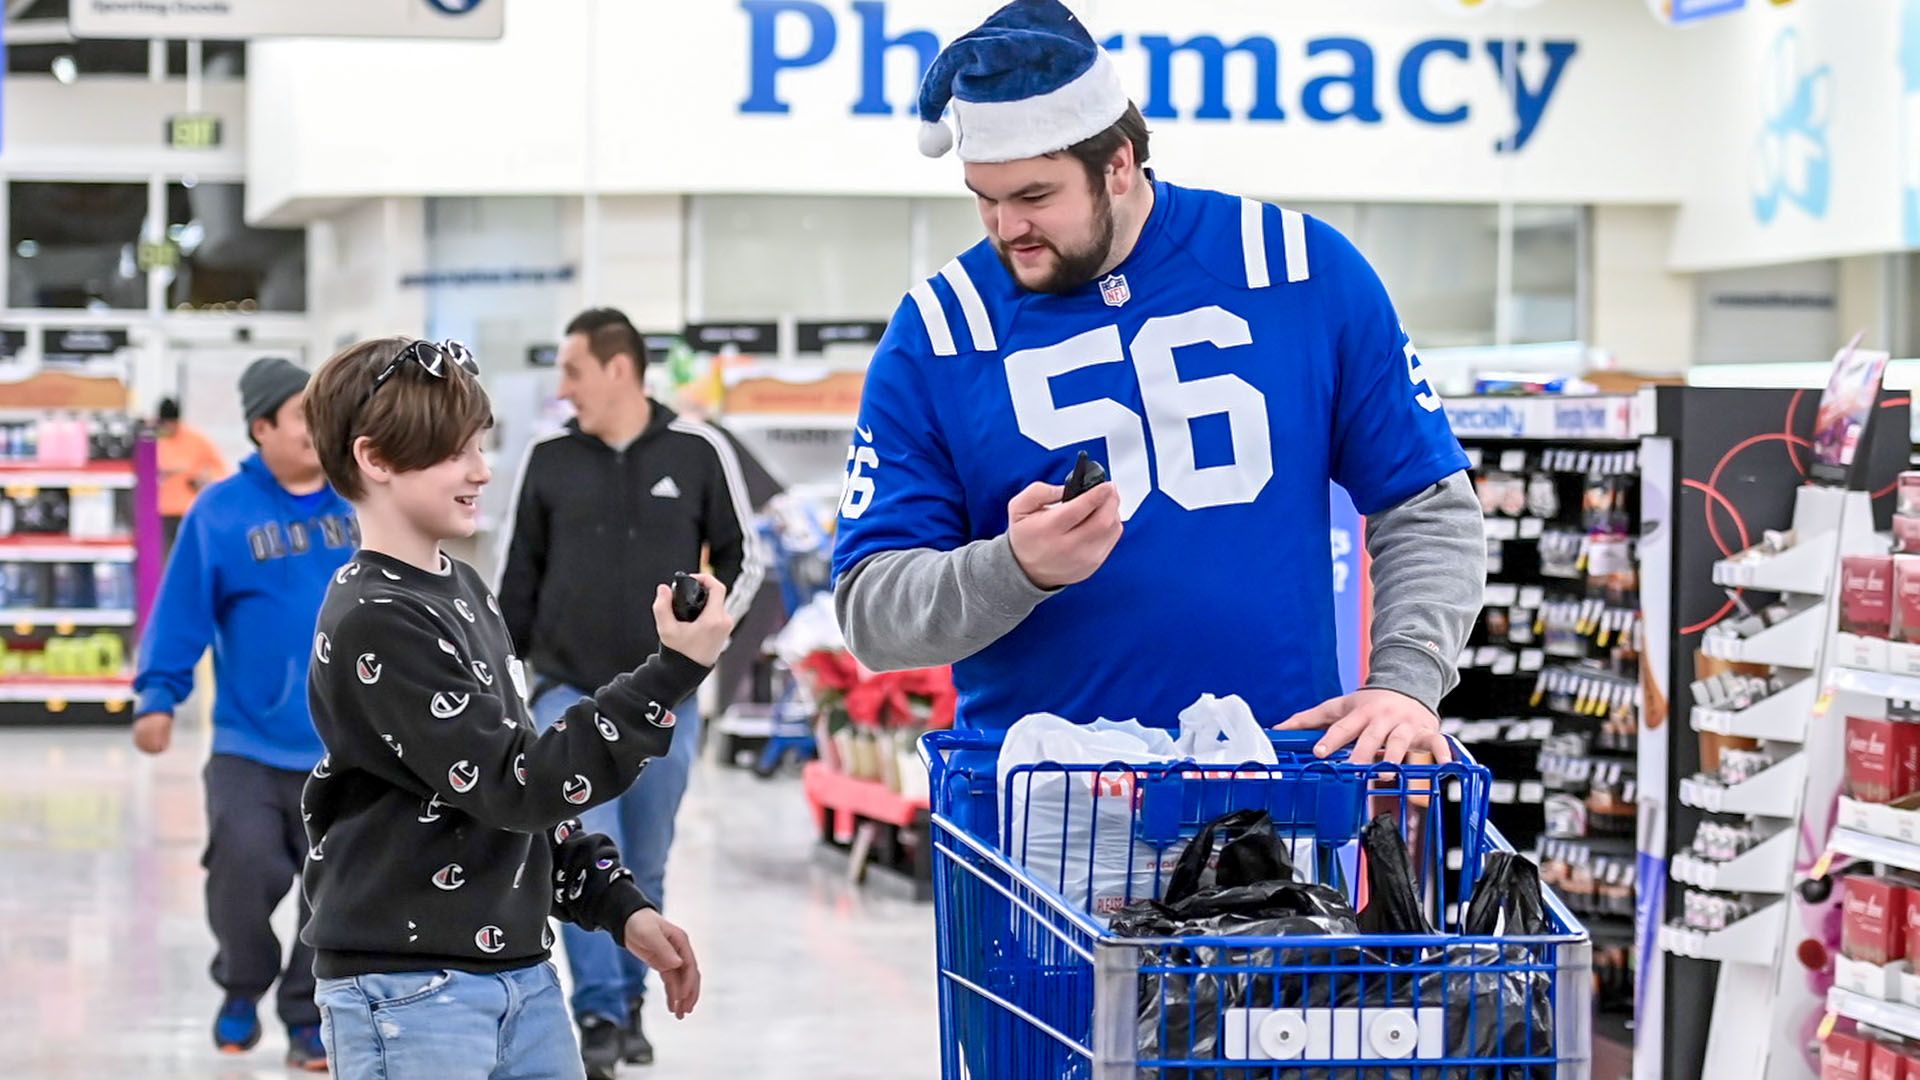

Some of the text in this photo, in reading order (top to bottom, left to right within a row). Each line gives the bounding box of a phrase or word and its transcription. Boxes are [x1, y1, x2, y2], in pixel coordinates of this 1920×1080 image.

[738, 0, 1578, 153] Phmacy
[1106, 289, 1128, 302] NFL
[1003, 305, 1274, 522] 56
[1448, 404, 1525, 437] pecialty
